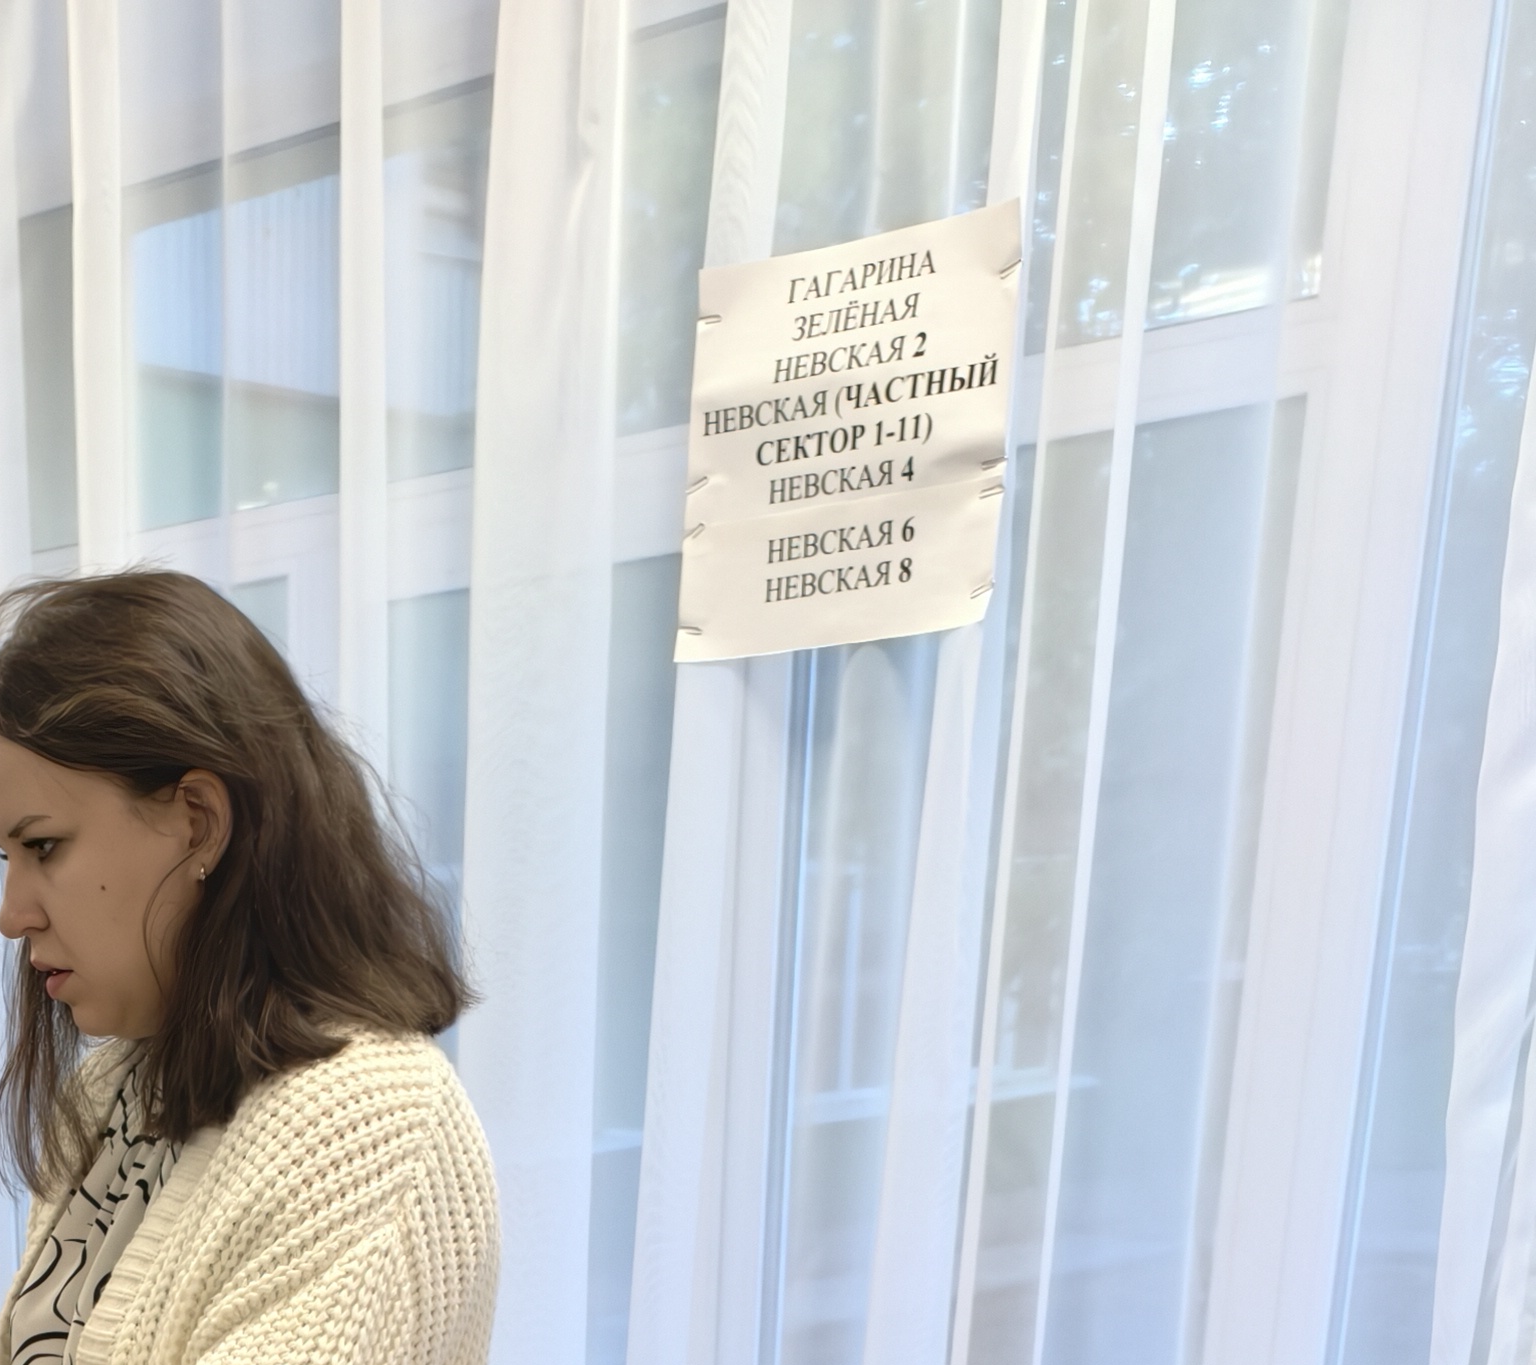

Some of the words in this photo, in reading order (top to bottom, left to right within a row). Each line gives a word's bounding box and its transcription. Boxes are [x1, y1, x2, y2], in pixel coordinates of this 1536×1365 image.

[787, 250, 936, 304] ГАГАРИНА
[791, 292, 921, 341] ЗЕЛЁНАЯ
[773, 335, 905, 384] НЕВСКАЯ
[913, 332, 927, 357] 2
[703, 390, 828, 437] НЕВСКАЯ
[834, 353, 999, 419] (ЧАСТНЫЙ
[756, 423, 866, 466] СЕКТОР
[874, 412, 933, 446] 1-11)
[768, 459, 893, 504] НЕВСКАЯ
[901, 456, 914, 482] 4
[767, 520, 893, 564] НЕВСКАЯ
[901, 516, 915, 542] 6
[764, 561, 891, 603] НЕВСКАЯ
[898, 557, 913, 583] 8
